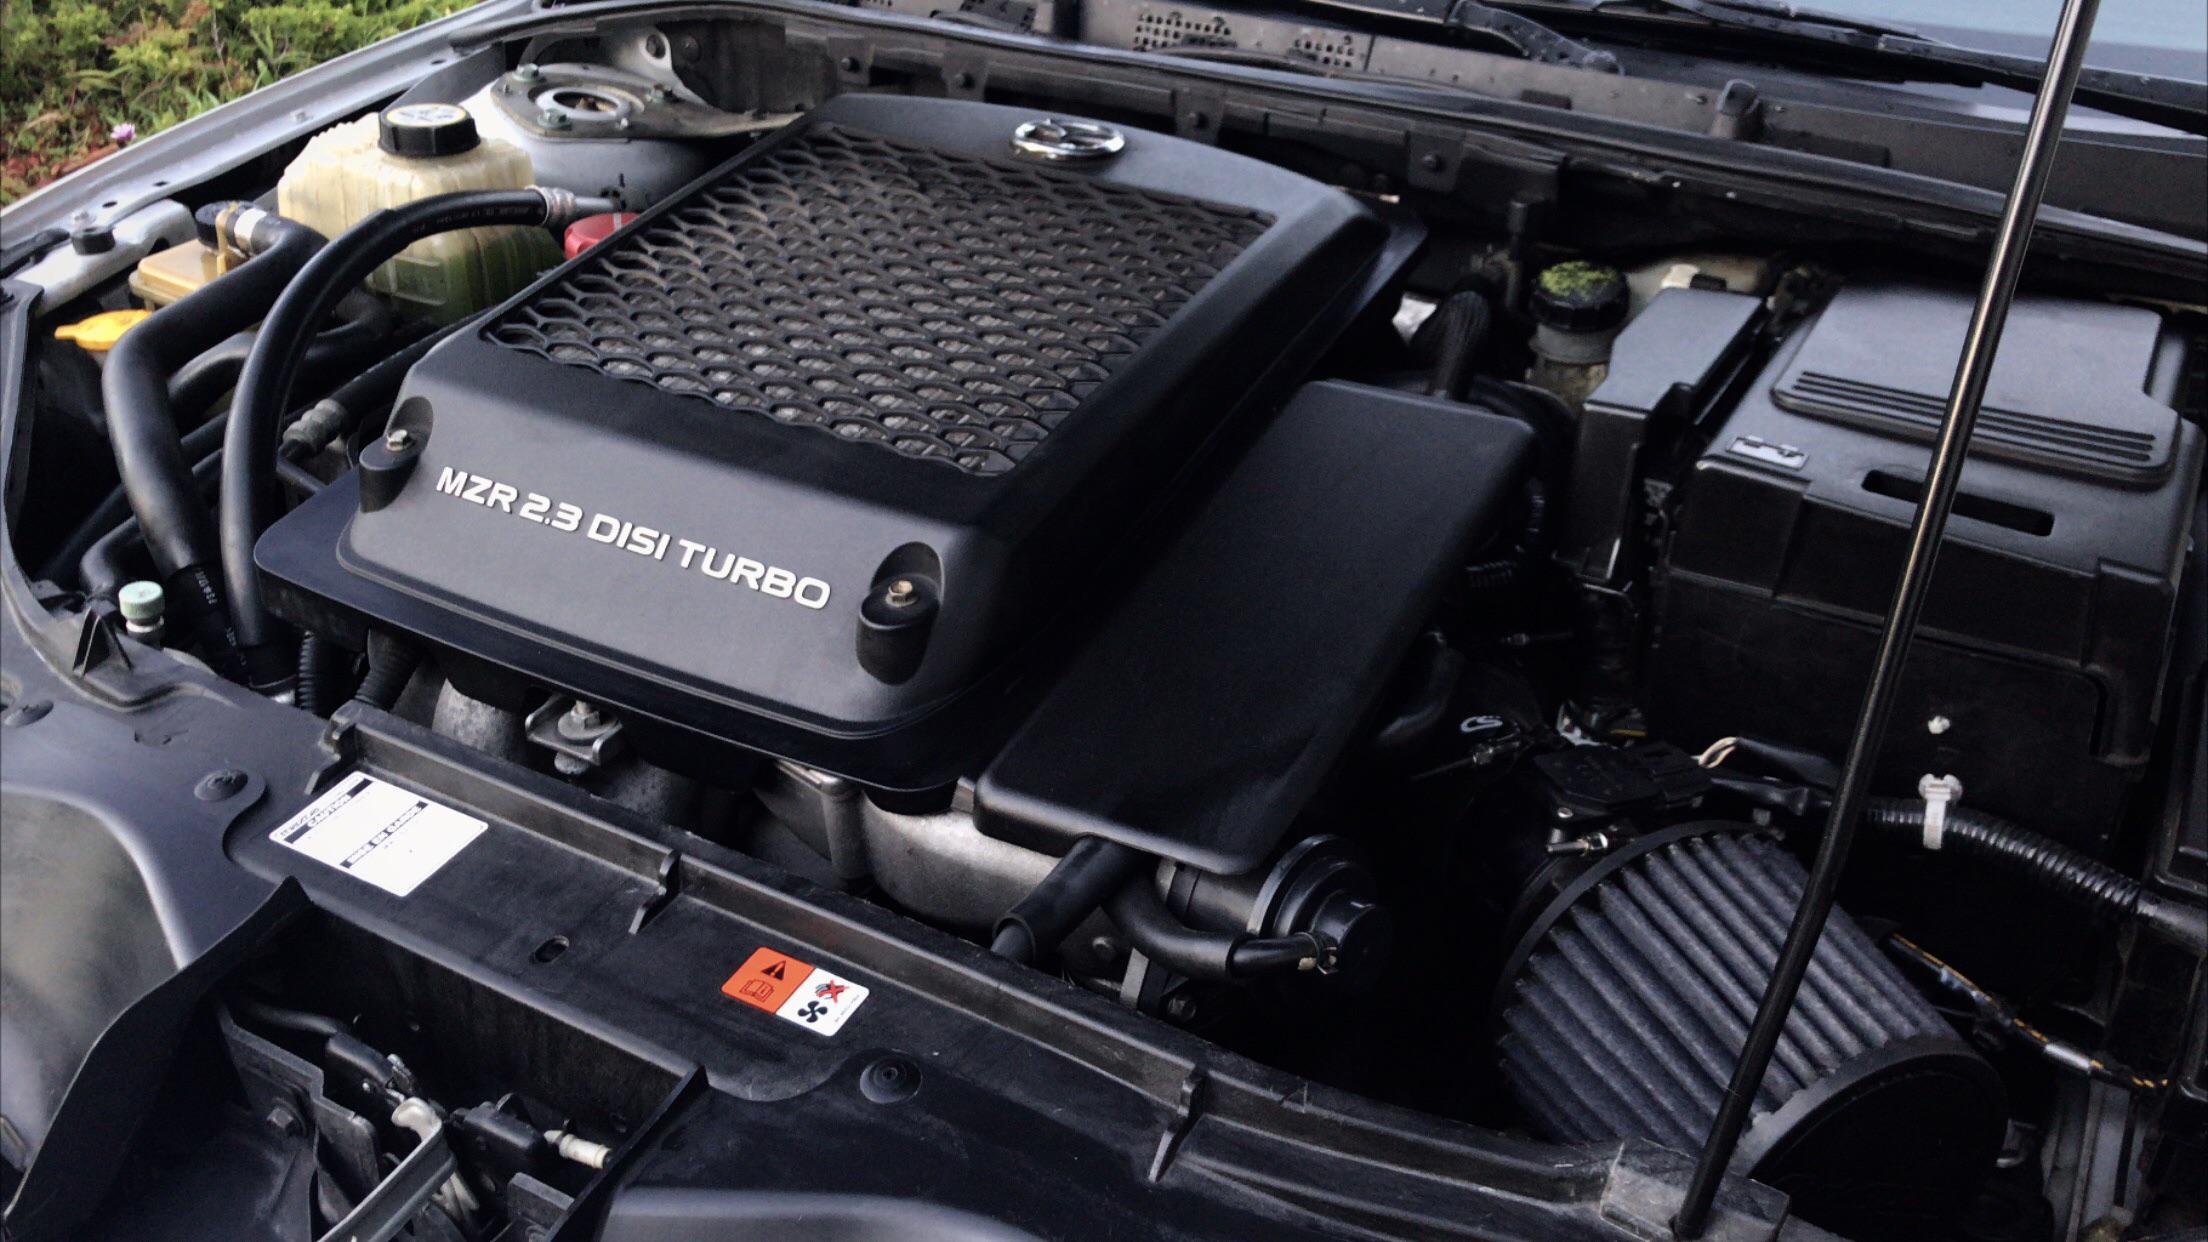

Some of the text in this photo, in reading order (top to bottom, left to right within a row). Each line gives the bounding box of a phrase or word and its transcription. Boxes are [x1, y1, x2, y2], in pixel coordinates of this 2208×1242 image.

[436, 467, 830, 609] MZR 2.3 DISI TURBO
